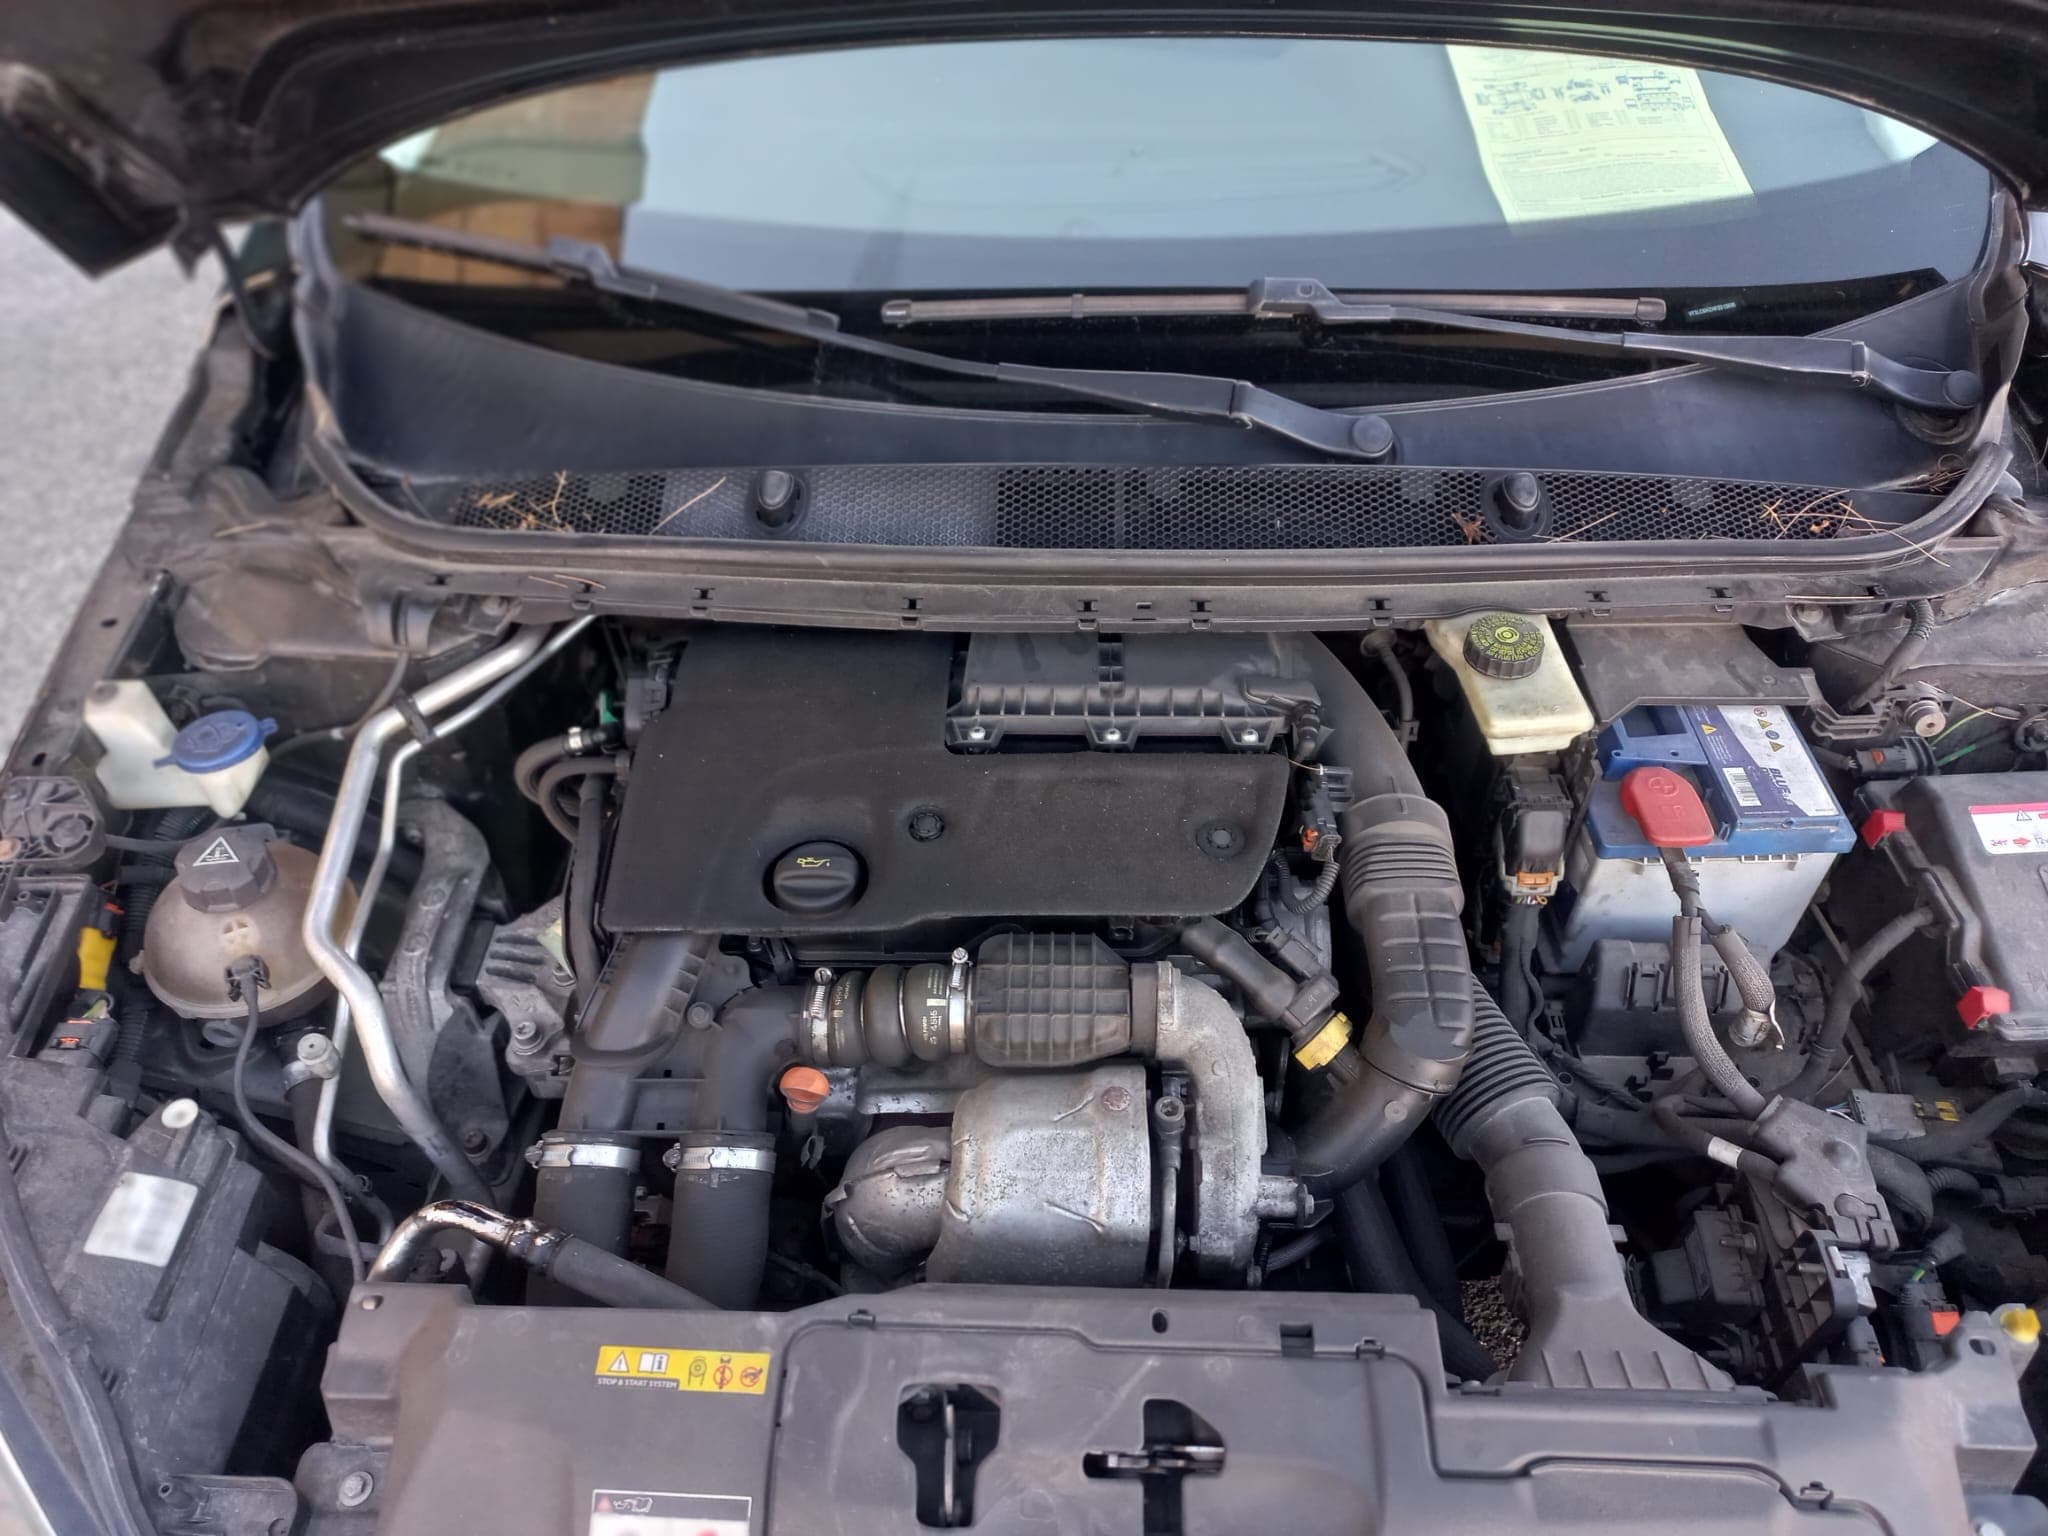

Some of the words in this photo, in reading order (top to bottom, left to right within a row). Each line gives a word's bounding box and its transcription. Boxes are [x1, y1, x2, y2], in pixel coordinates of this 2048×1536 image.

[597, 1377, 618, 1386] STOP
[624, 1379, 648, 1387] START
[649, 1380, 678, 1389] SYSTEM
